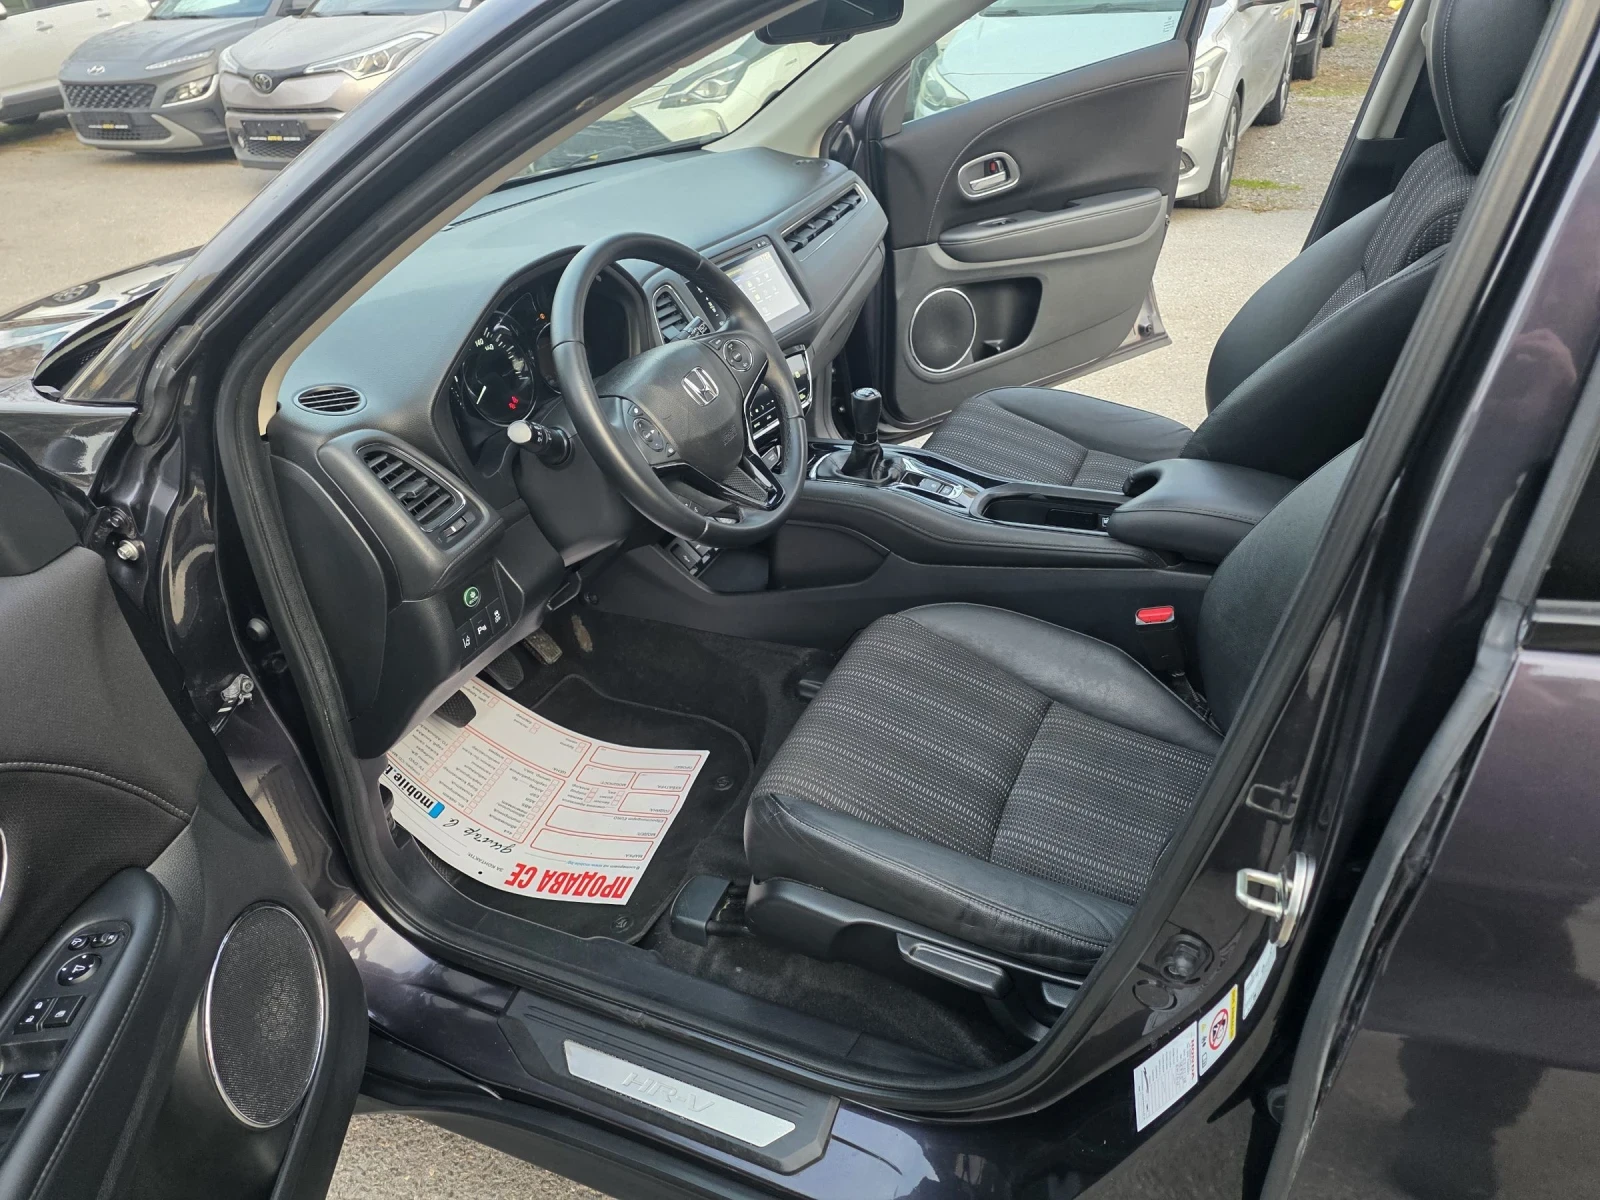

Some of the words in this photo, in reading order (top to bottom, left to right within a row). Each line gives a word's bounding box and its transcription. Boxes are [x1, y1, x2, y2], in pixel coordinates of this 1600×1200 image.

[384, 764, 433, 808] mobile.b
[504, 863, 538, 889] СЕ
[536, 870, 633, 898] ПРОДАВА
[622, 1072, 715, 1112] HR-V
